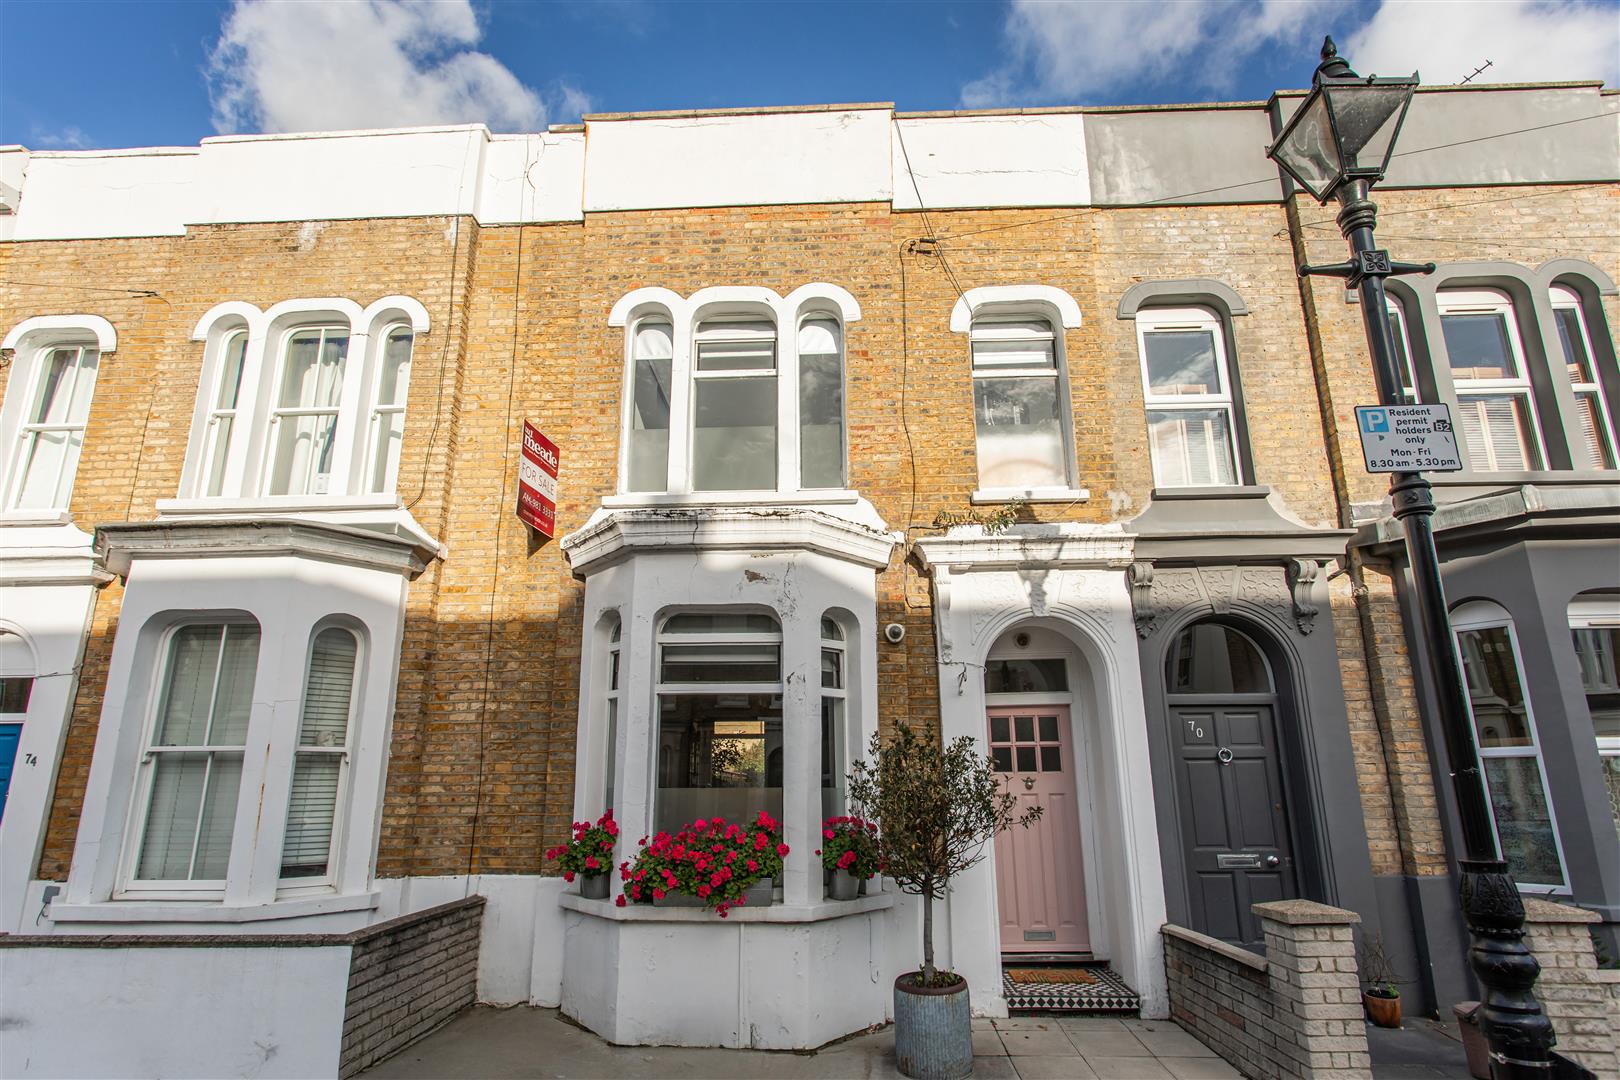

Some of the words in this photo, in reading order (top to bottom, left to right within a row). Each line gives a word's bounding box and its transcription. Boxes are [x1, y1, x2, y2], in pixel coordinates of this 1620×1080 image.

[1389, 408, 1431, 416] Resident
[1366, 411, 1384, 431] P
[1396, 418, 1428, 426] permit
[1395, 427, 1432, 435] holders
[1405, 435, 1426, 444] only
[524, 434, 557, 468] meade
[522, 462, 537, 483] FOR
[538, 475, 554, 496] SALE
[25, 753, 37, 767] 74
